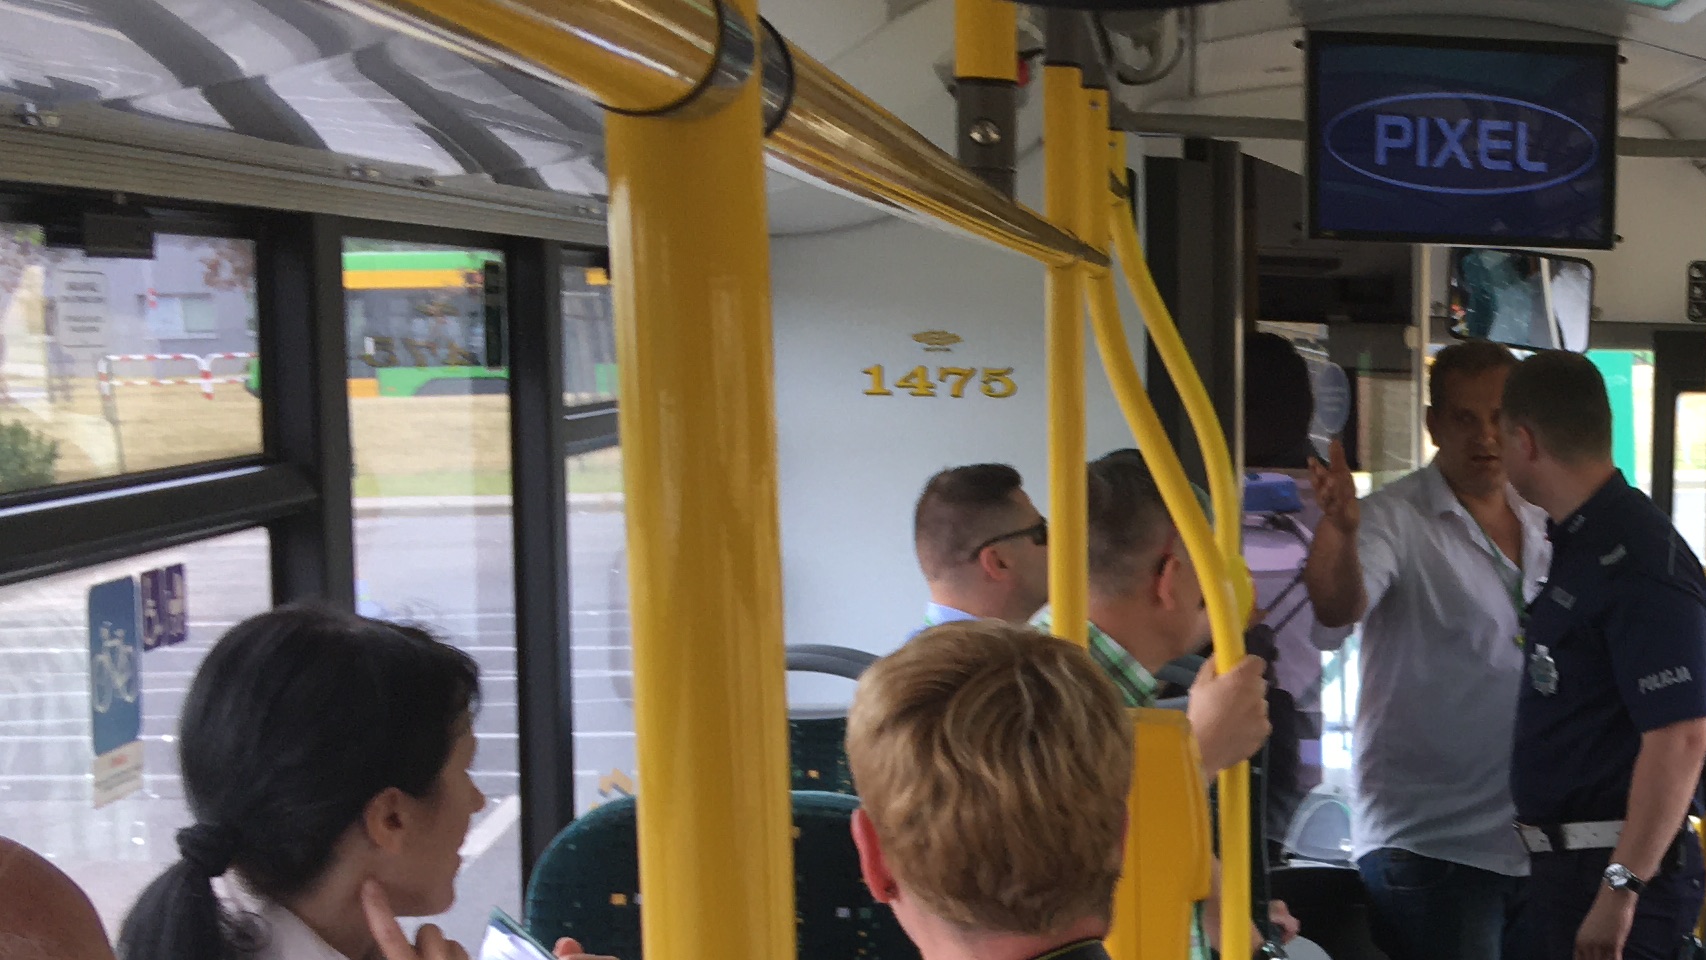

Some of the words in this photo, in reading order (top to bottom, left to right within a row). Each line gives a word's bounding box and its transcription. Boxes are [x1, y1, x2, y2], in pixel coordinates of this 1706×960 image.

[1374, 114, 1548, 173] PIXEL
[861, 363, 1019, 398] 1475
[1638, 665, 1692, 694] POLICJA
